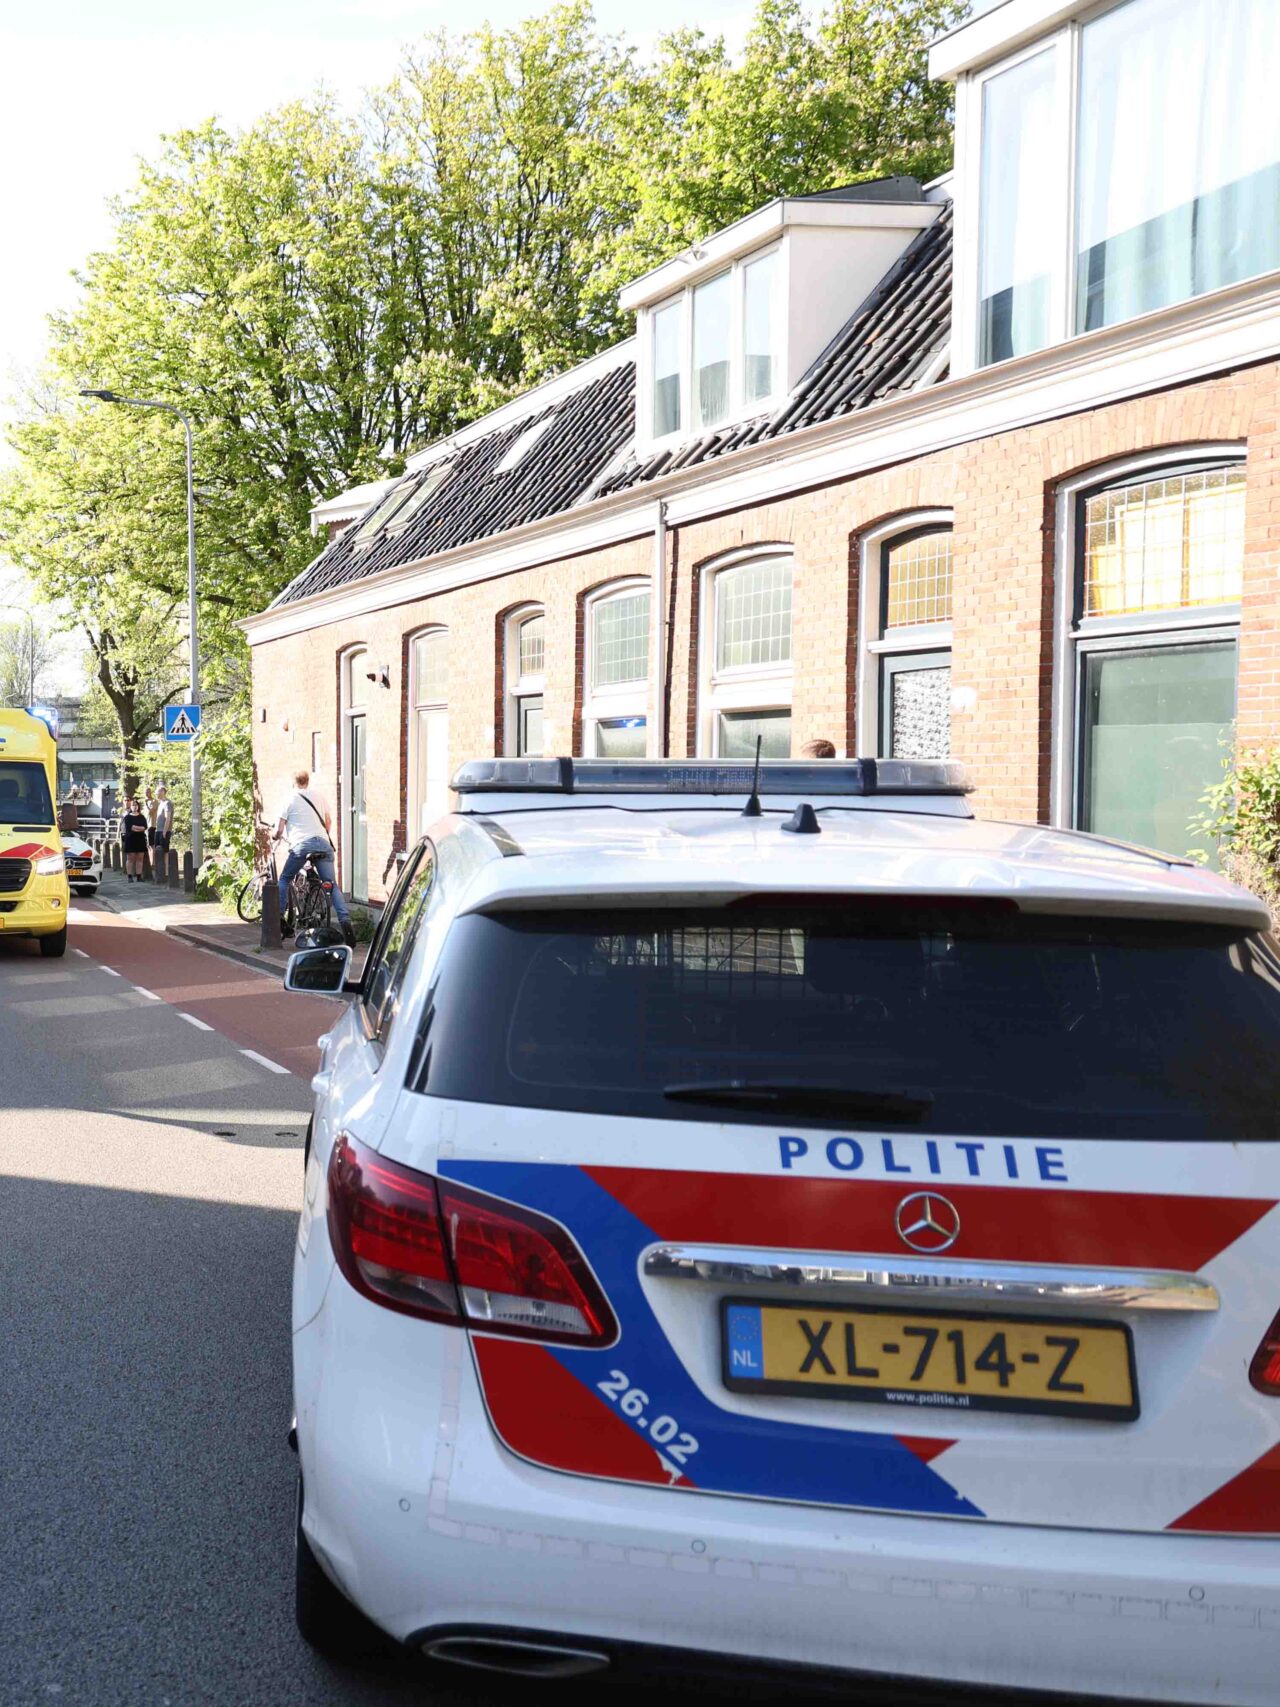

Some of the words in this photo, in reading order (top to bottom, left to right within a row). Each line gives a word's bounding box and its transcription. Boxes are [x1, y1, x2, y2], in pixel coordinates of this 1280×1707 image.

[778, 1136, 1069, 1182] POLITIE
[733, 1349, 758, 1367] NL
[798, 1319, 1085, 1393] XL-714-Z
[597, 1369, 699, 1464] 26.02
[885, 1391, 970, 1406] www.politie.nl
